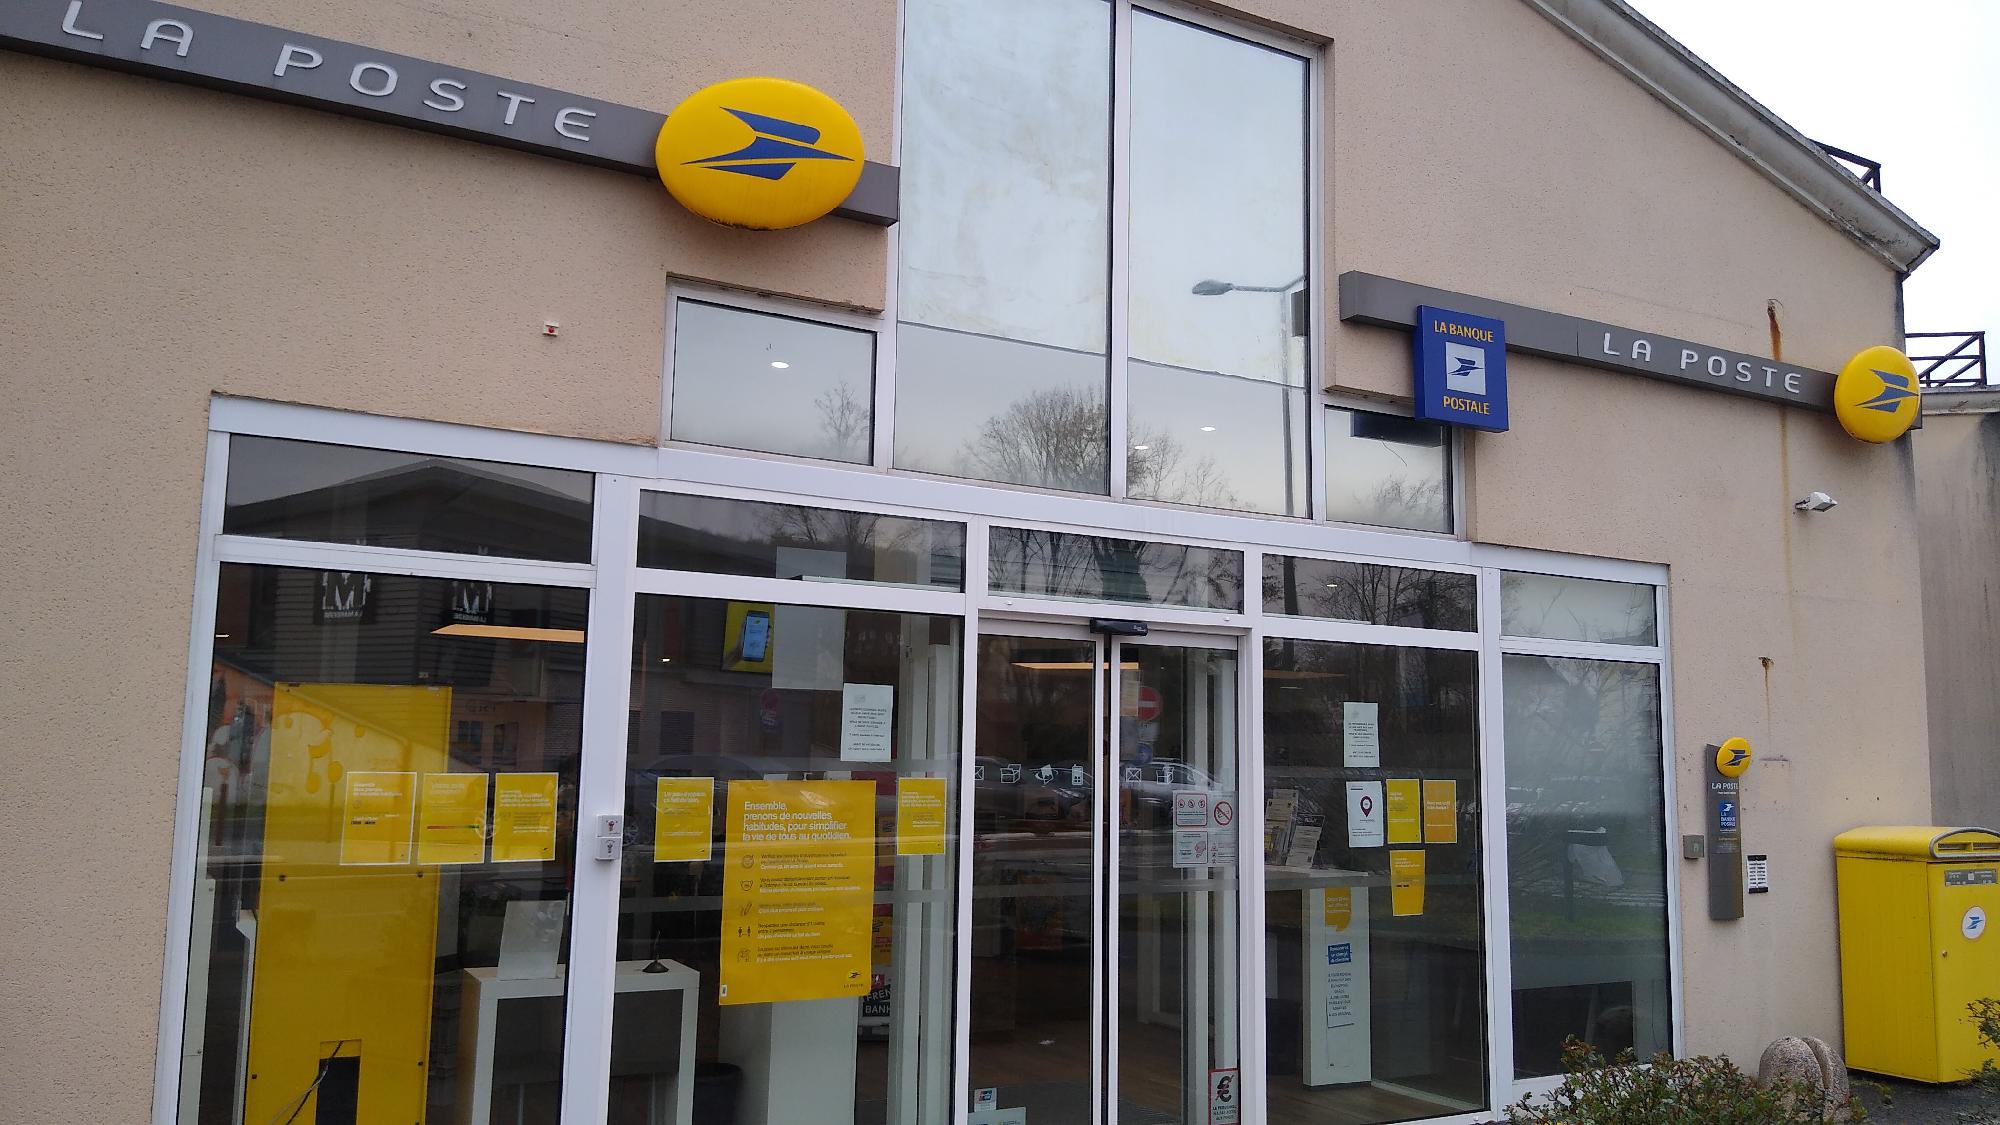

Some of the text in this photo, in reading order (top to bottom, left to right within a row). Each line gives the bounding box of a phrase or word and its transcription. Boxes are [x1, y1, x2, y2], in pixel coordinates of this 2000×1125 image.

[62, 0, 597, 142] LA POSTE
[1434, 320, 1494, 342] LA BANQUE
[1603, 332, 1801, 394] LA POSTE
[1443, 395, 1490, 415] POSTALE
[1711, 782, 1722, 790] LA
[744, 801, 788, 811] Ensemble,
[743, 810, 832, 821] prenons de nouvelles
[743, 821, 848, 833] habitudes, pour simplifier
[742, 832, 750, 841] la
[752, 832, 765, 841] vie
[766, 832, 777, 841] de
[778, 832, 797, 841] tous
[799, 832, 810, 840] au
